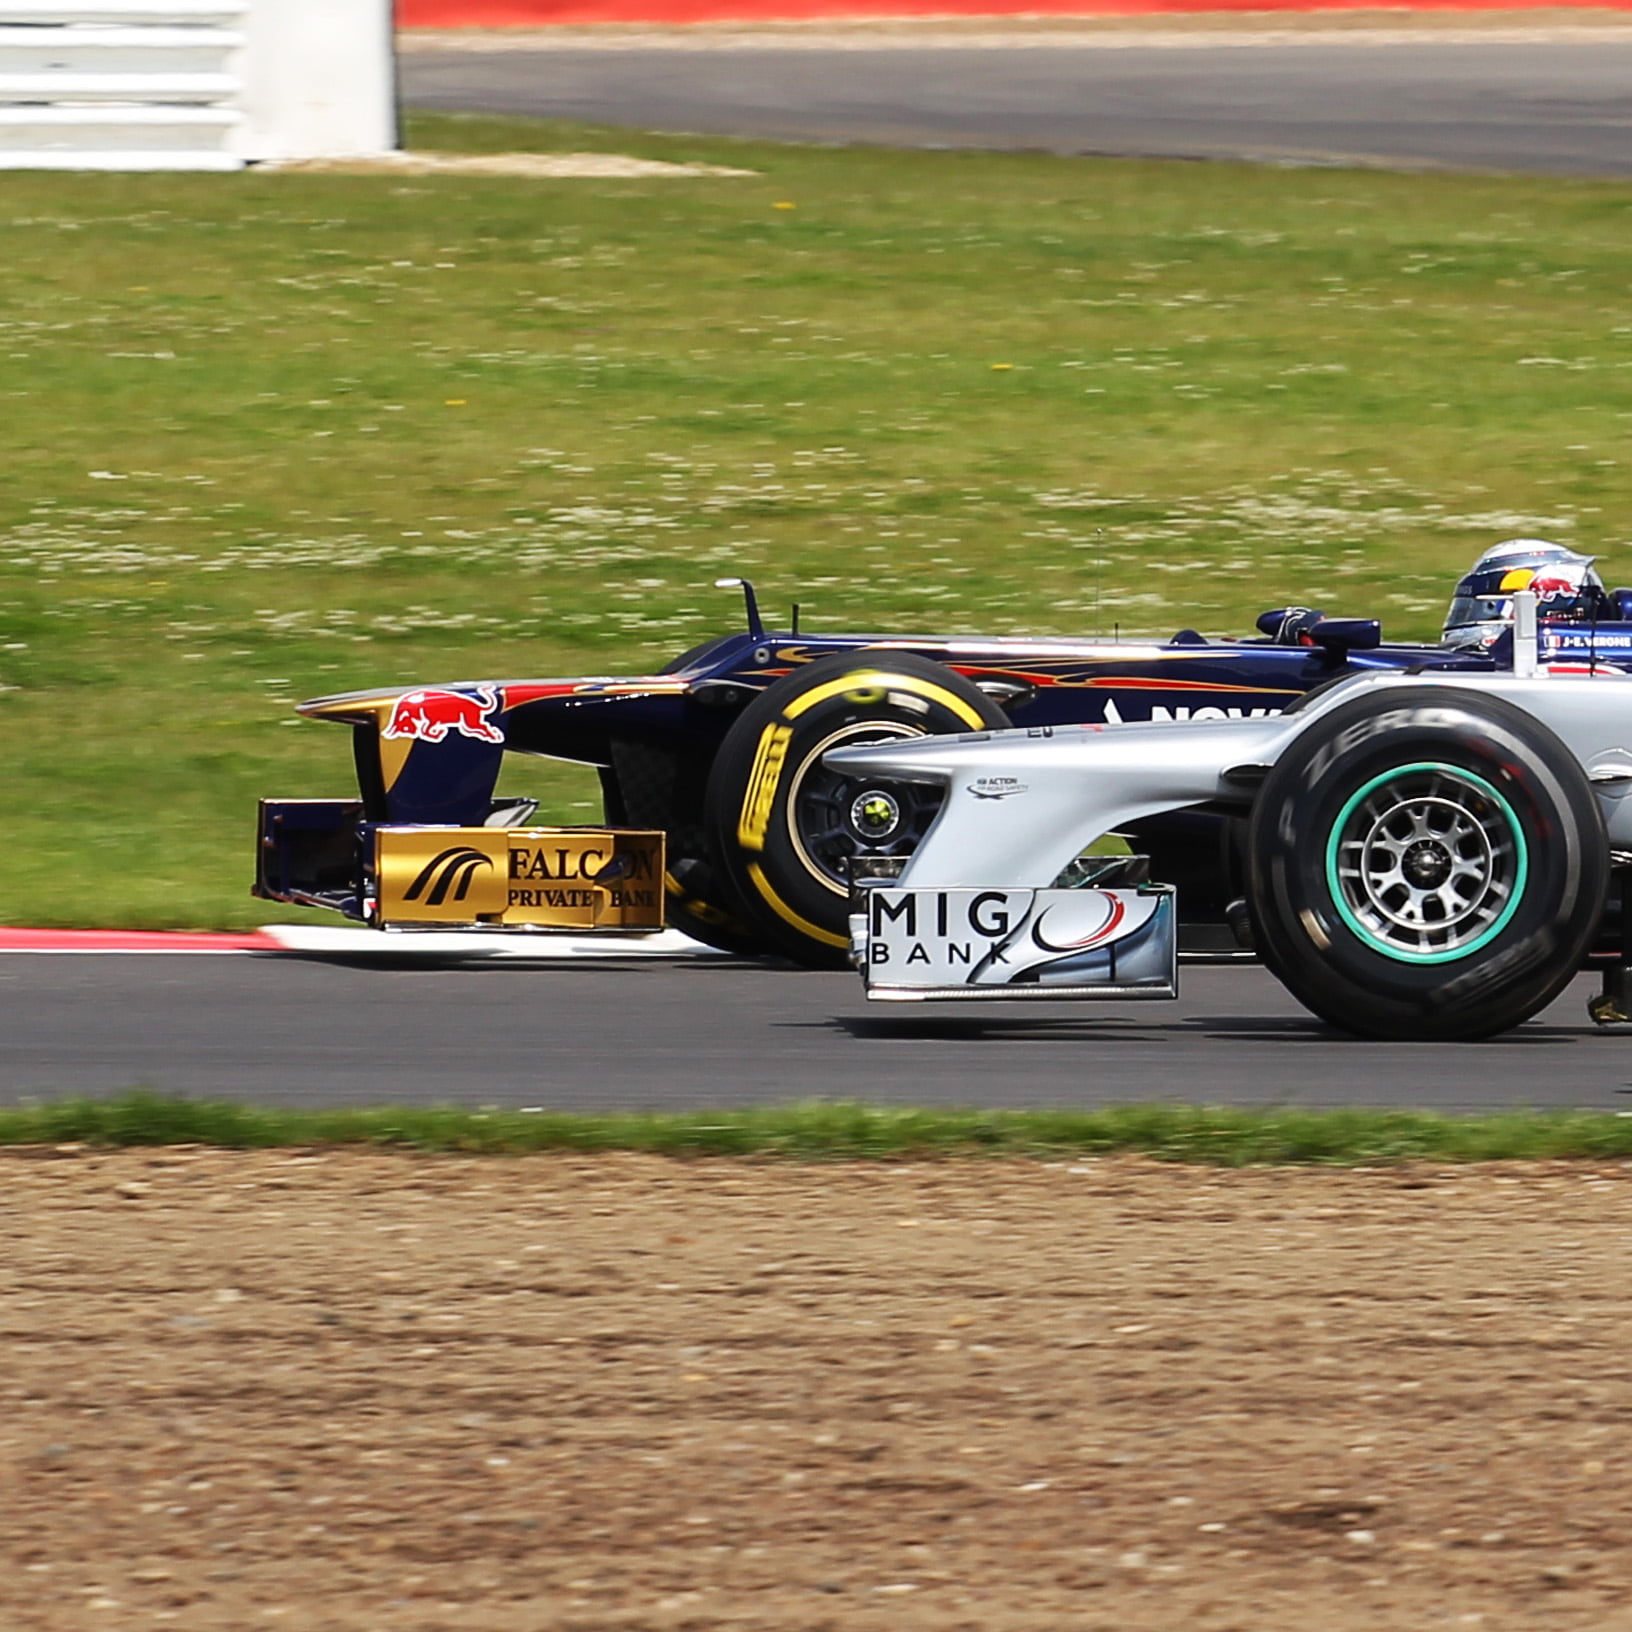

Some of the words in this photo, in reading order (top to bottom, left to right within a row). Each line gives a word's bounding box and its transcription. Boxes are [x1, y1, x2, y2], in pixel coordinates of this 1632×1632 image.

[508, 886, 594, 908] PRIVATE
[611, 887, 655, 908] BANK
[872, 891, 1009, 937] MIG
[871, 942, 1012, 965] BANK
